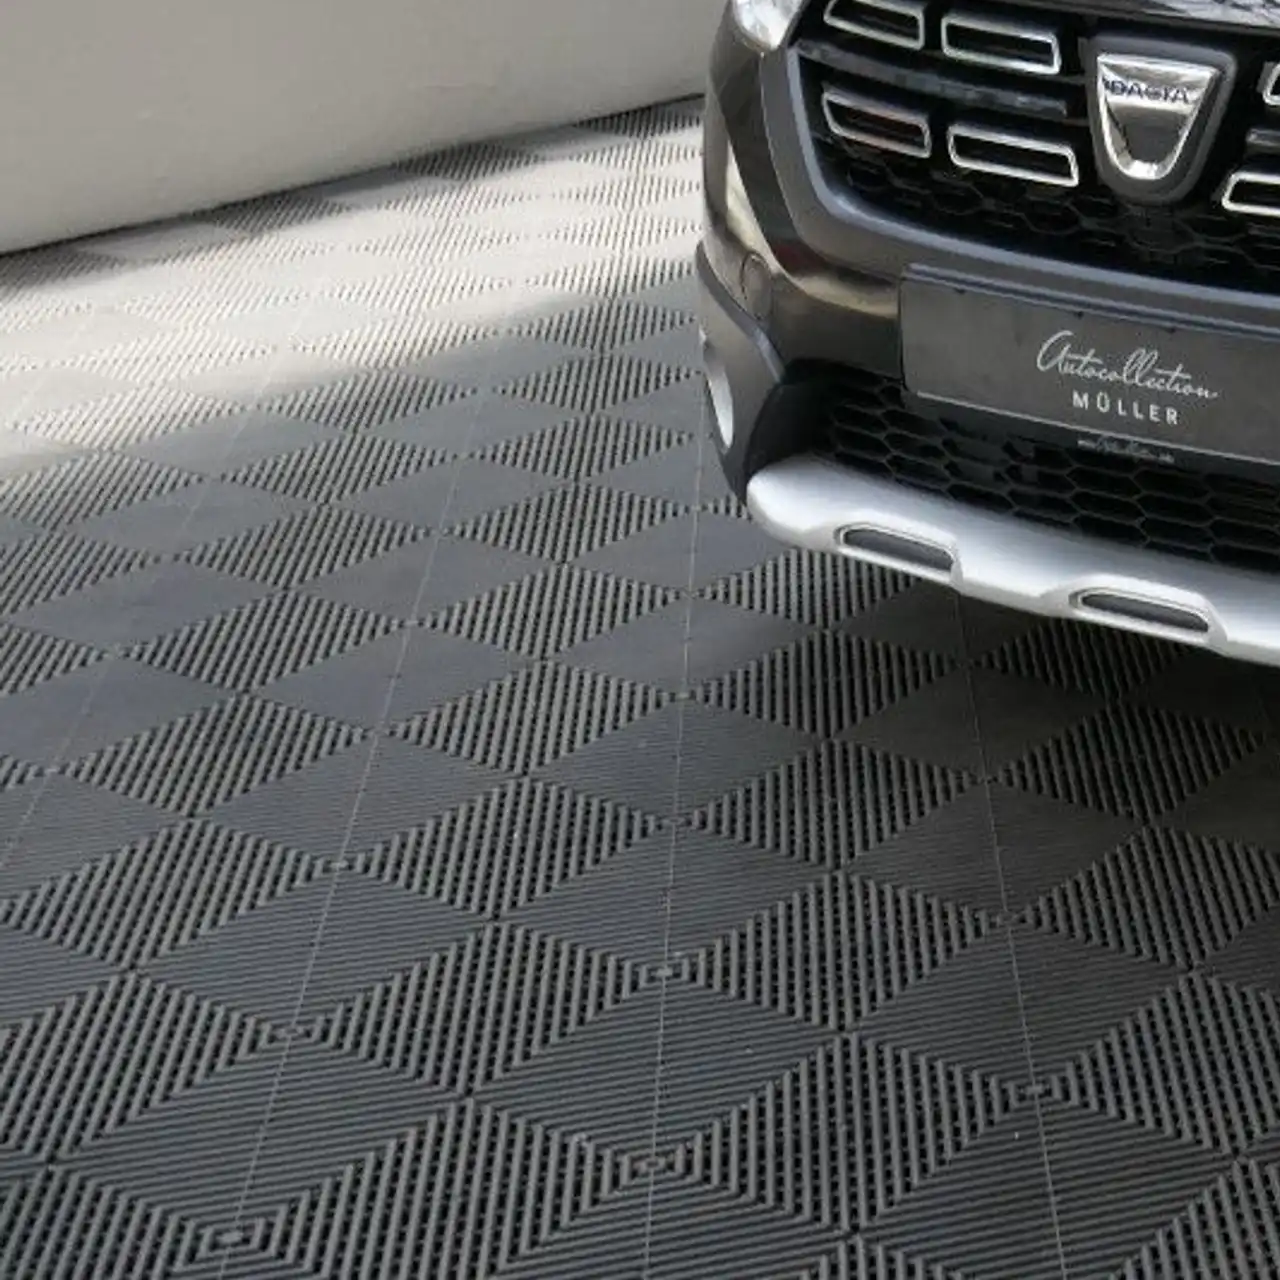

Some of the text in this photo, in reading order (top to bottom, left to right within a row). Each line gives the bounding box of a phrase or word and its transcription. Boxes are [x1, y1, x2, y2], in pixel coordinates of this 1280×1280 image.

[1110, 79, 1190, 105] DACIA
[1036, 329, 1221, 399] Autocollection
[1072, 388, 1180, 426] MÜLLER
